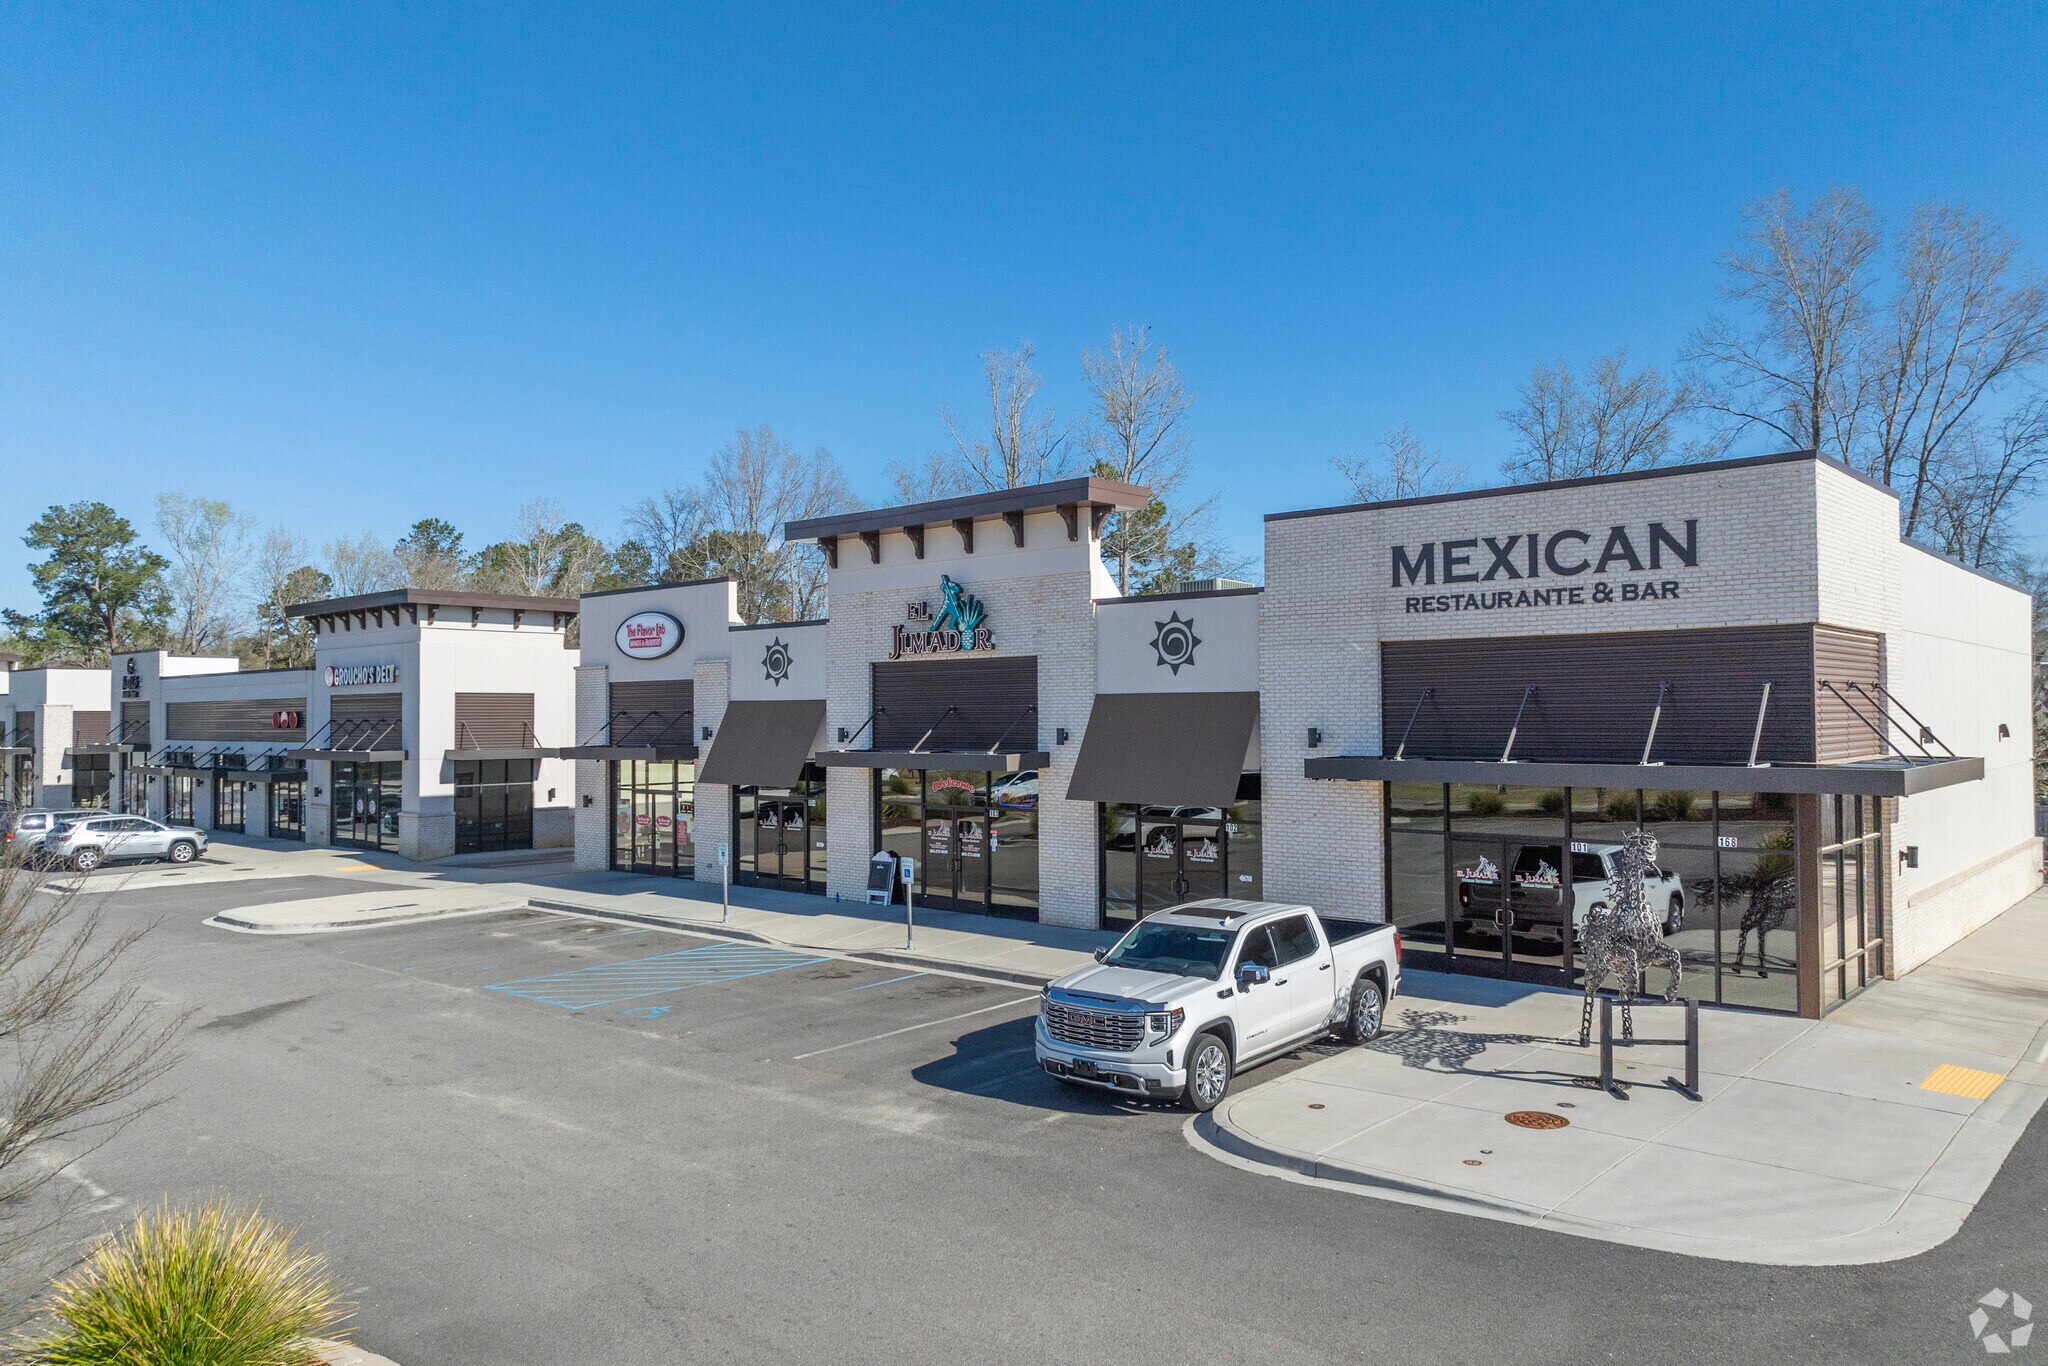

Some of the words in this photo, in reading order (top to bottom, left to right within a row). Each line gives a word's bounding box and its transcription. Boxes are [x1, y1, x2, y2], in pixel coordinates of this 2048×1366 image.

[1391, 519, 1699, 587] MEXICAN
[1405, 586, 1584, 613] RESTAURANTE
[1591, 581, 1613, 604] &
[1621, 580, 1680, 601] BAR
[907, 602, 930, 621] EL
[626, 624, 636, 638] The
[637, 623, 655, 637] Flavor
[656, 623, 666, 636] Lab
[334, 666, 374, 686] GROUCHO'S
[932, 777, 975, 793] Welcome
[1226, 823, 1237, 832] 102
[1571, 842, 1587, 852] 101
[1720, 837, 1736, 848] 168
[1068, 1012, 1105, 1026] GMC
